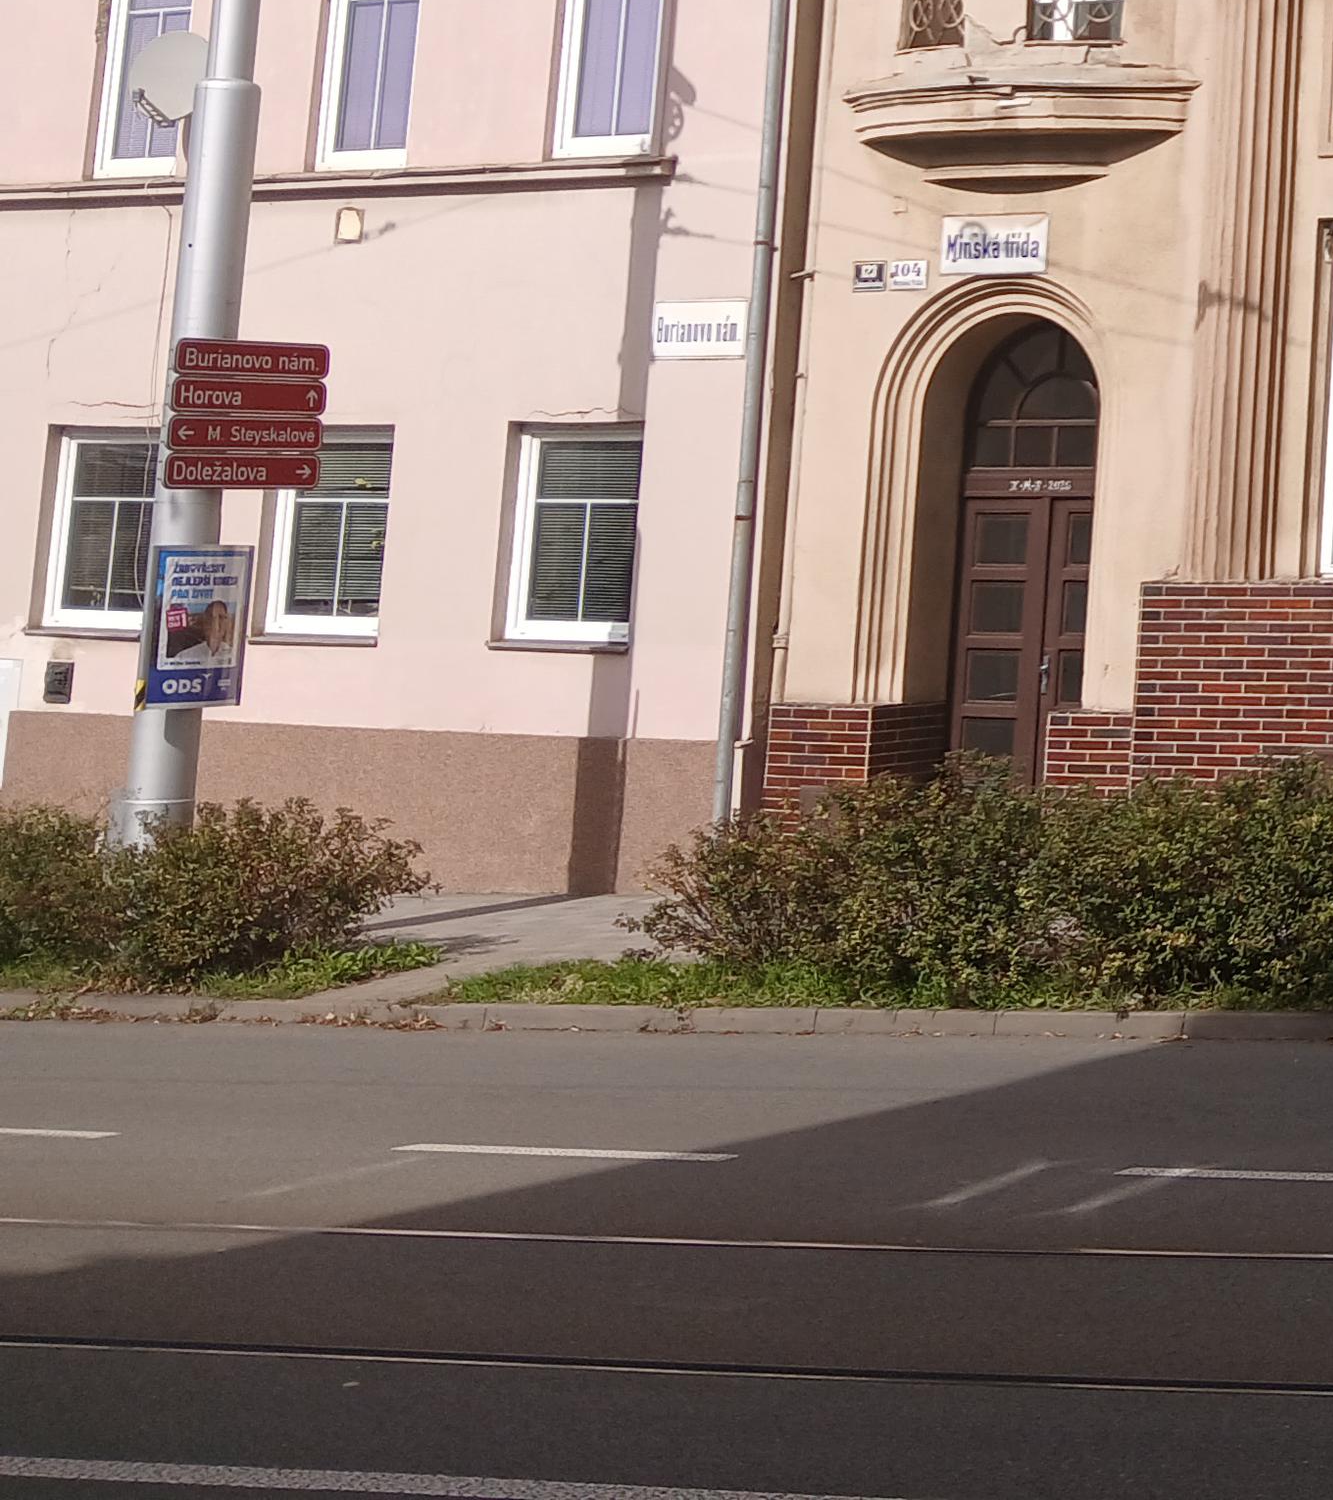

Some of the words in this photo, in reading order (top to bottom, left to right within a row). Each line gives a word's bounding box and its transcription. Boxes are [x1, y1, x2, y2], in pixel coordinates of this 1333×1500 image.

[890, 263, 921, 277] 104
[656, 316, 712, 343] Burianovo
[185, 348, 272, 369] Burianovo
[279, 353, 319, 372] nám.
[180, 384, 242, 405] Horova
[207, 425, 224, 441] M.
[230, 425, 315, 445] Steyskalové
[173, 460, 267, 481] Doležalova
[162, 678, 202, 695] ODS
